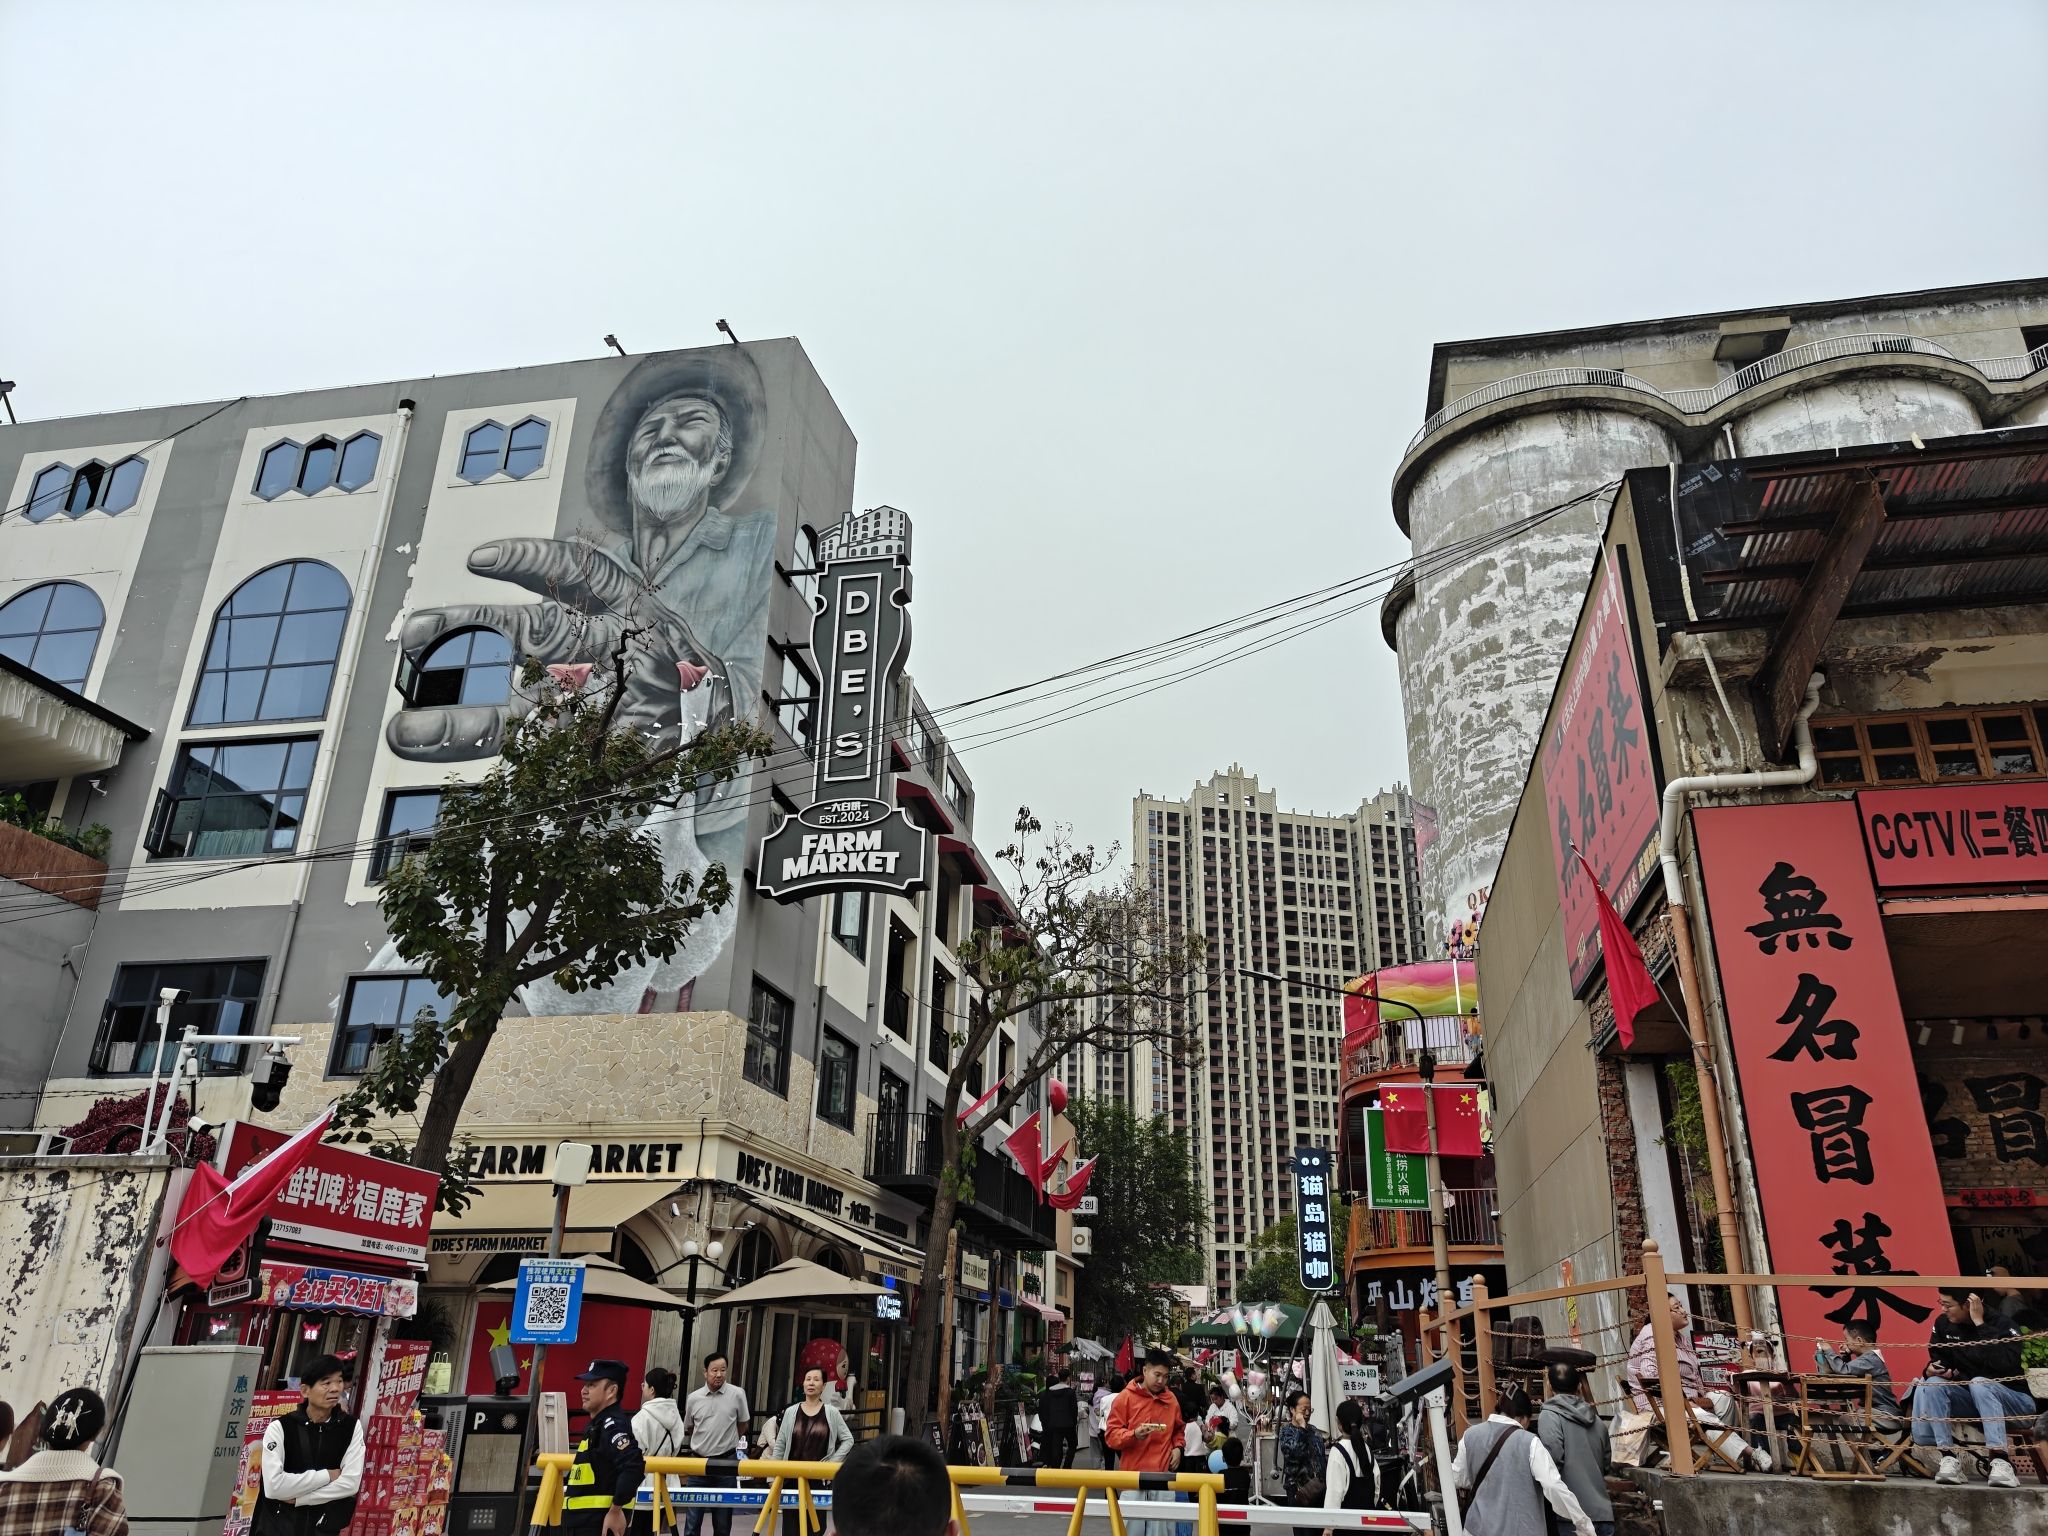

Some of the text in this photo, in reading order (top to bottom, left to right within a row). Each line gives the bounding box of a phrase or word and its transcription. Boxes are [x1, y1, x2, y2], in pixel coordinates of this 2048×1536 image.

[835, 590, 870, 757] DBE'S
[819, 810, 870, 824] EST.2024
[801, 829, 882, 855] FARM
[782, 851, 900, 881] MARKET
[1744, 861, 1934, 1331] 無名冒菜
[467, 1143, 683, 1175] FARM ARKET
[1395, 1152, 1410, 1197] 捞火锅
[286, 1166, 428, 1229] 鲜啤 福鹿家
[736, 1150, 773, 1192] DBE'S
[774, 1164, 805, 1202] FARM
[805, 1178, 844, 1216] MARKET
[432, 1236, 548, 1251] DBE'S FARM MARKET
[1300, 1175, 1329, 1279] 猫岛猫咖
[291, 1274, 386, 1312] 全场买2送1
[225, 1375, 249, 1439] 惠济区
[473, 1411, 486, 1431] P
